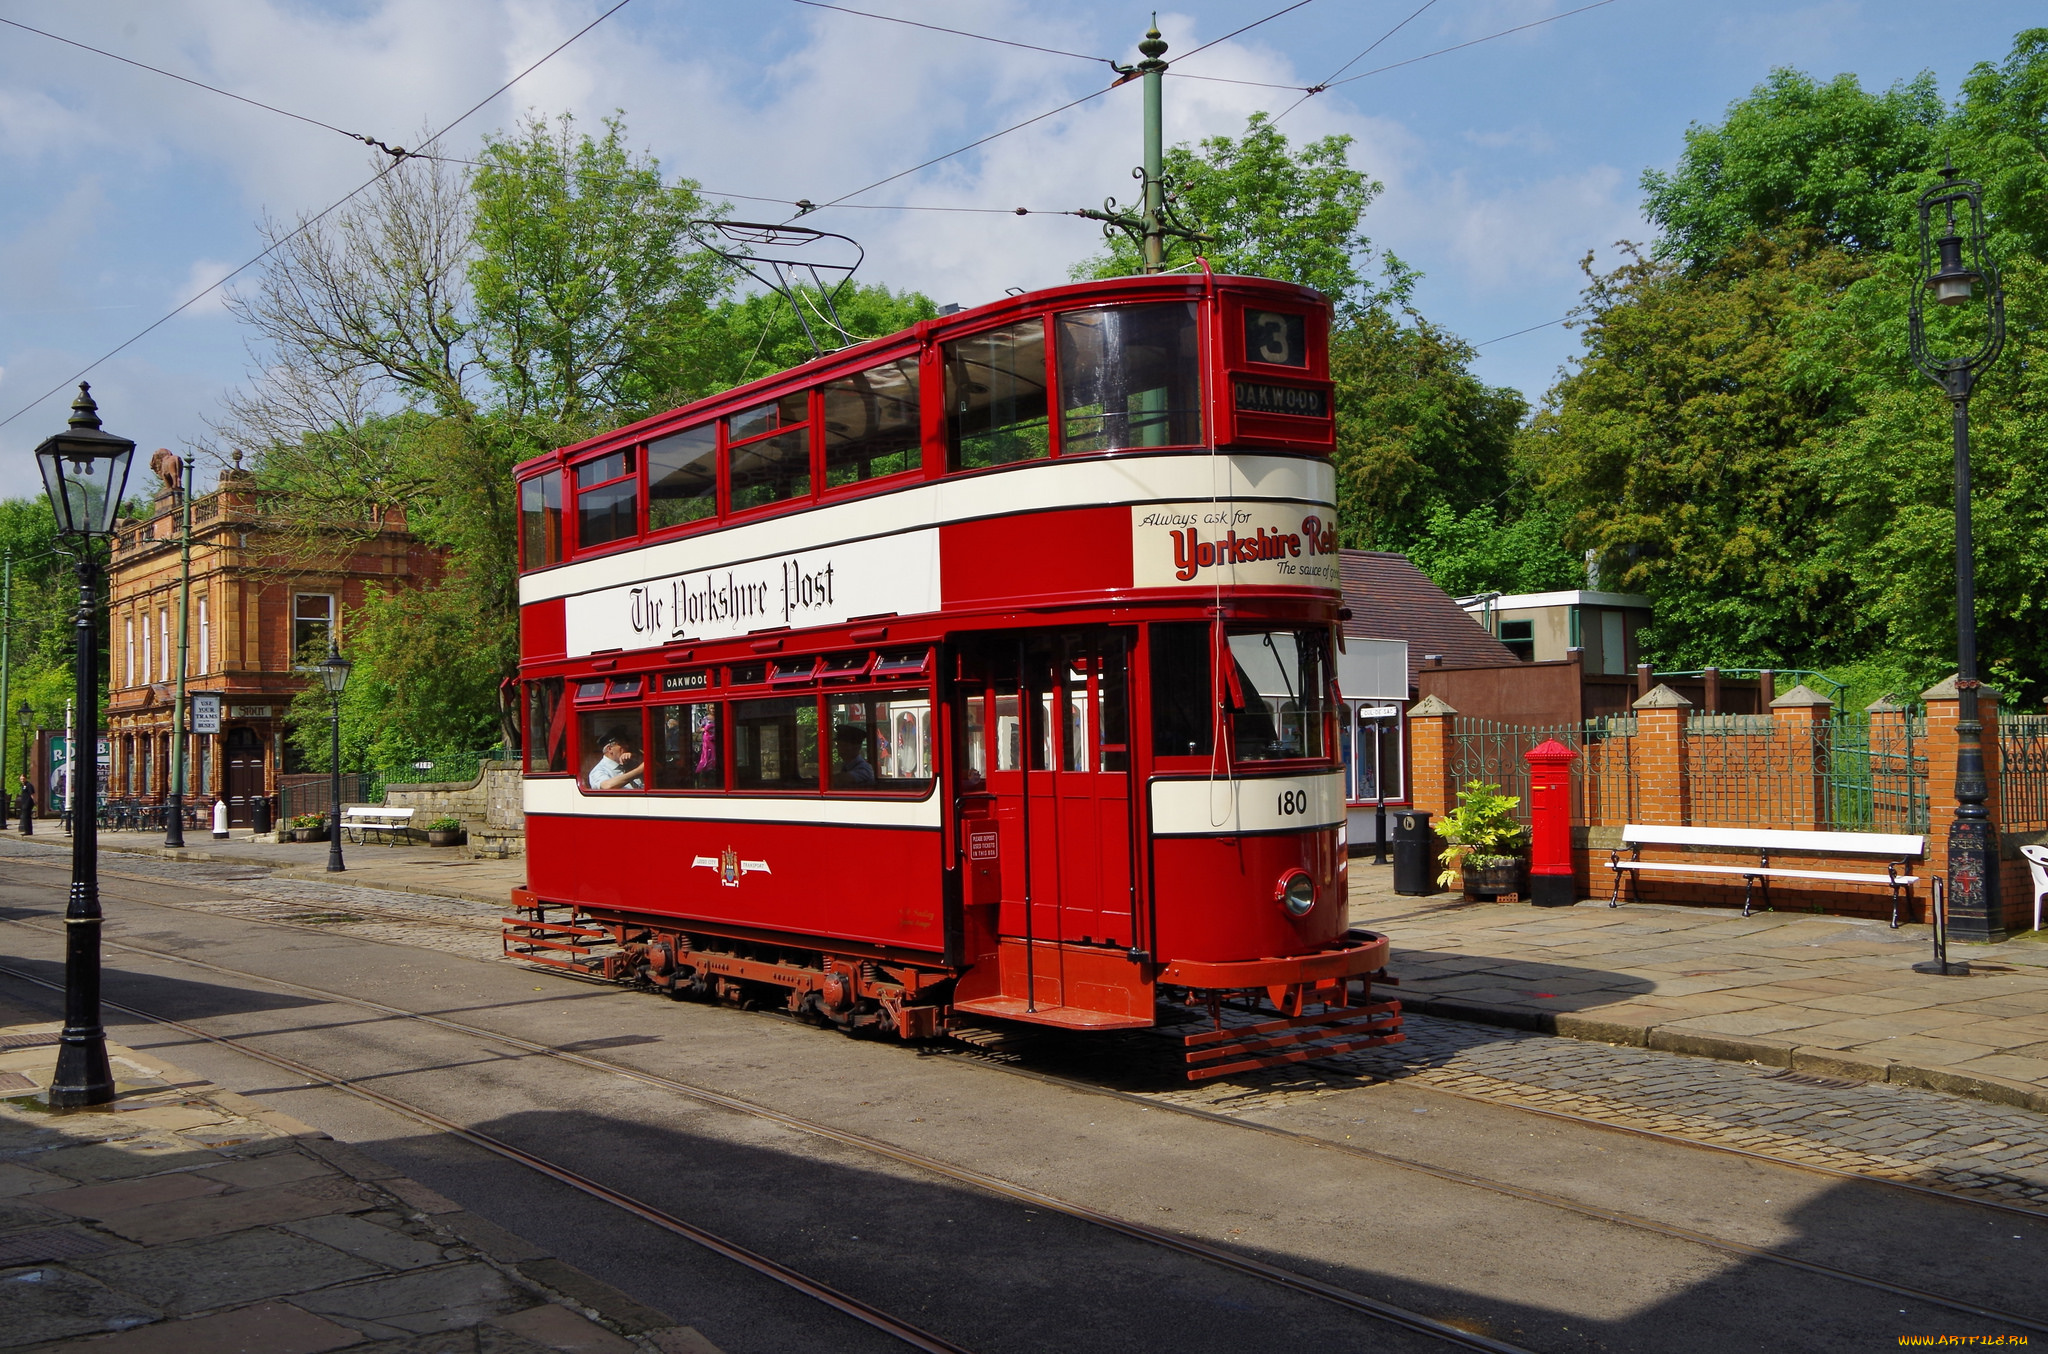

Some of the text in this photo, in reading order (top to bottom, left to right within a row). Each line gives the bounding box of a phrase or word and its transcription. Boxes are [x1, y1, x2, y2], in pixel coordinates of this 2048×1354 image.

[1258, 312, 1289, 363] 3
[1235, 383, 1318, 411] OAKWOOD
[1138, 509, 1252, 528] Always ask for
[1169, 526, 1301, 582] Yorkshire
[1277, 561, 1297, 575] The
[1299, 565, 1322, 577] sauce
[1323, 564, 1331, 580] of
[629, 558, 834, 641] The Yorkshire Post
[1277, 790, 1307, 815] 180
